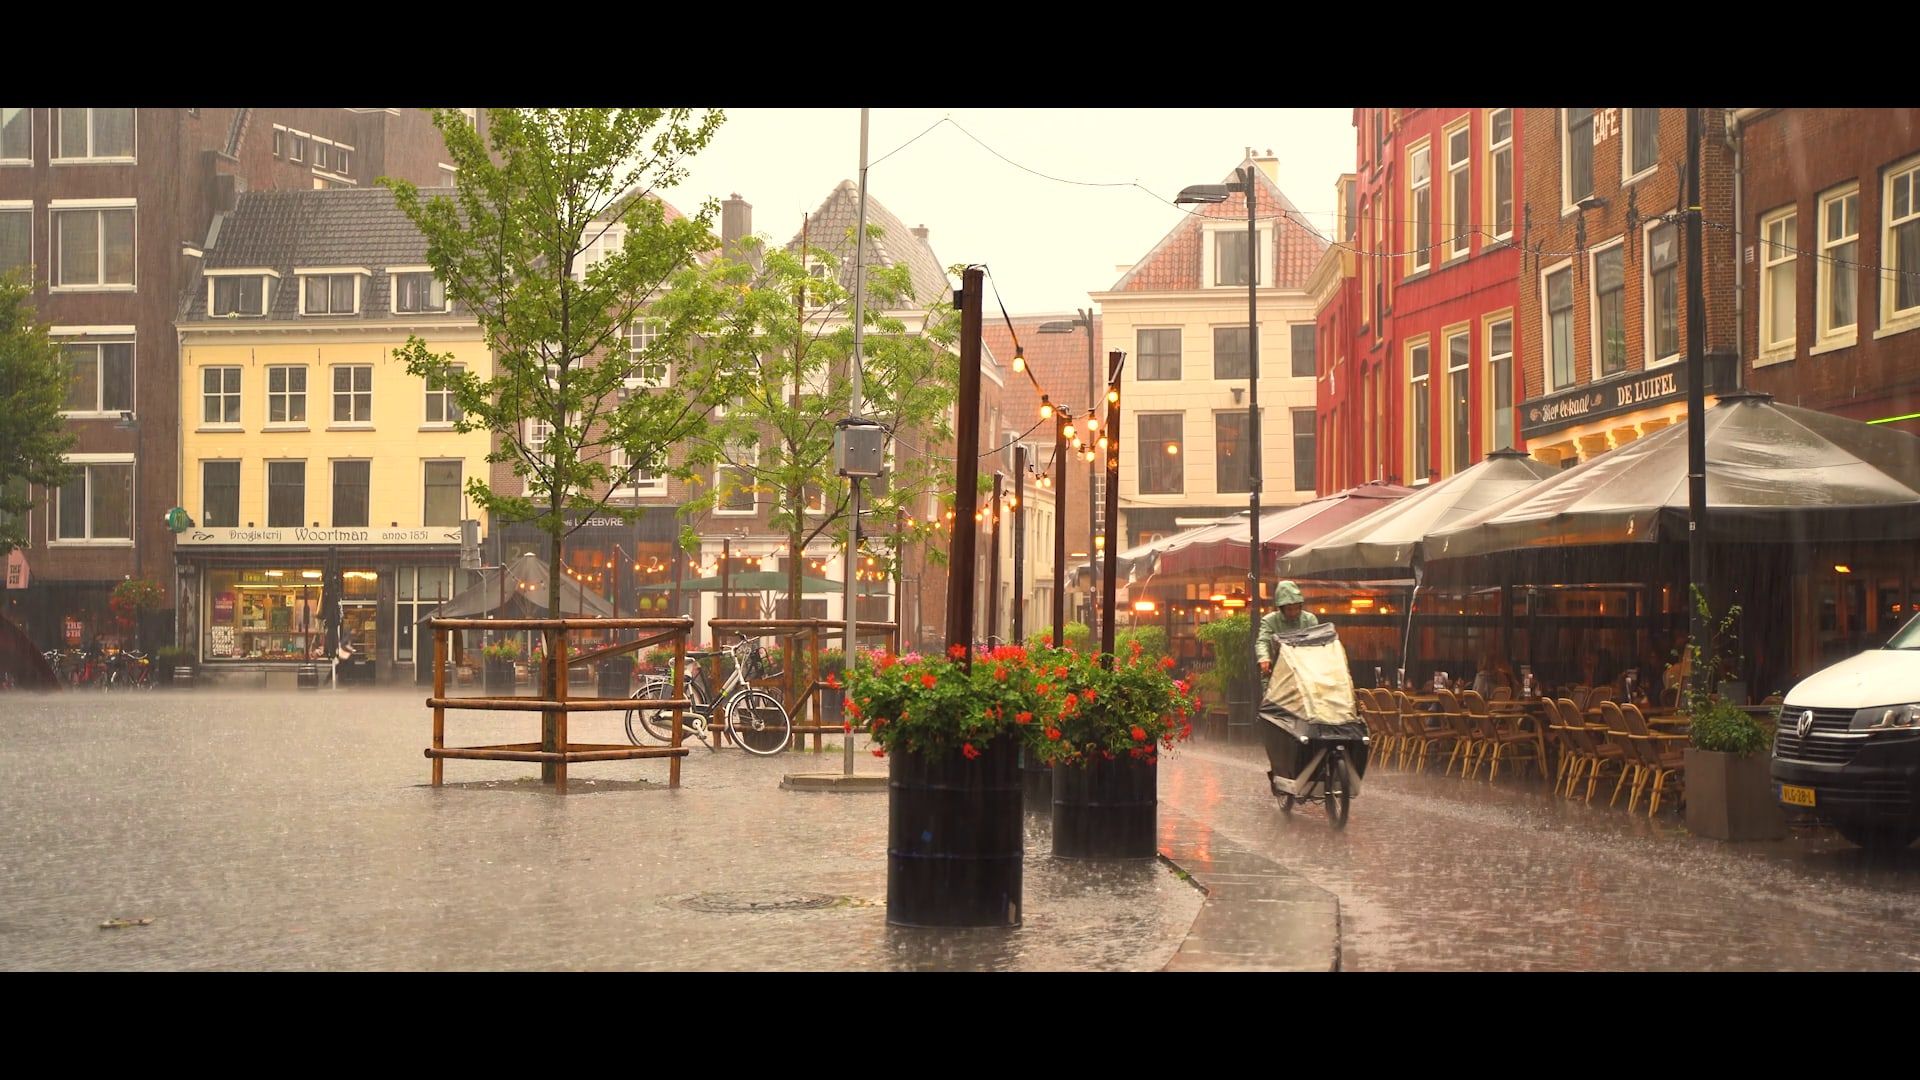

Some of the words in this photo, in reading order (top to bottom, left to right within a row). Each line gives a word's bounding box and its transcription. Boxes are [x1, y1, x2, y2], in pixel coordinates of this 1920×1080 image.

[1616, 384, 1633, 406] DE
[1634, 373, 1677, 402] LUIFEL
[1542, 404, 1559, 422] Bier
[229, 530, 282, 542] Drogisterij
[294, 528, 369, 541] Woortman
[382, 532, 408, 540] anno
[409, 531, 429, 540] 1851
[67, 621, 82, 629] THE
